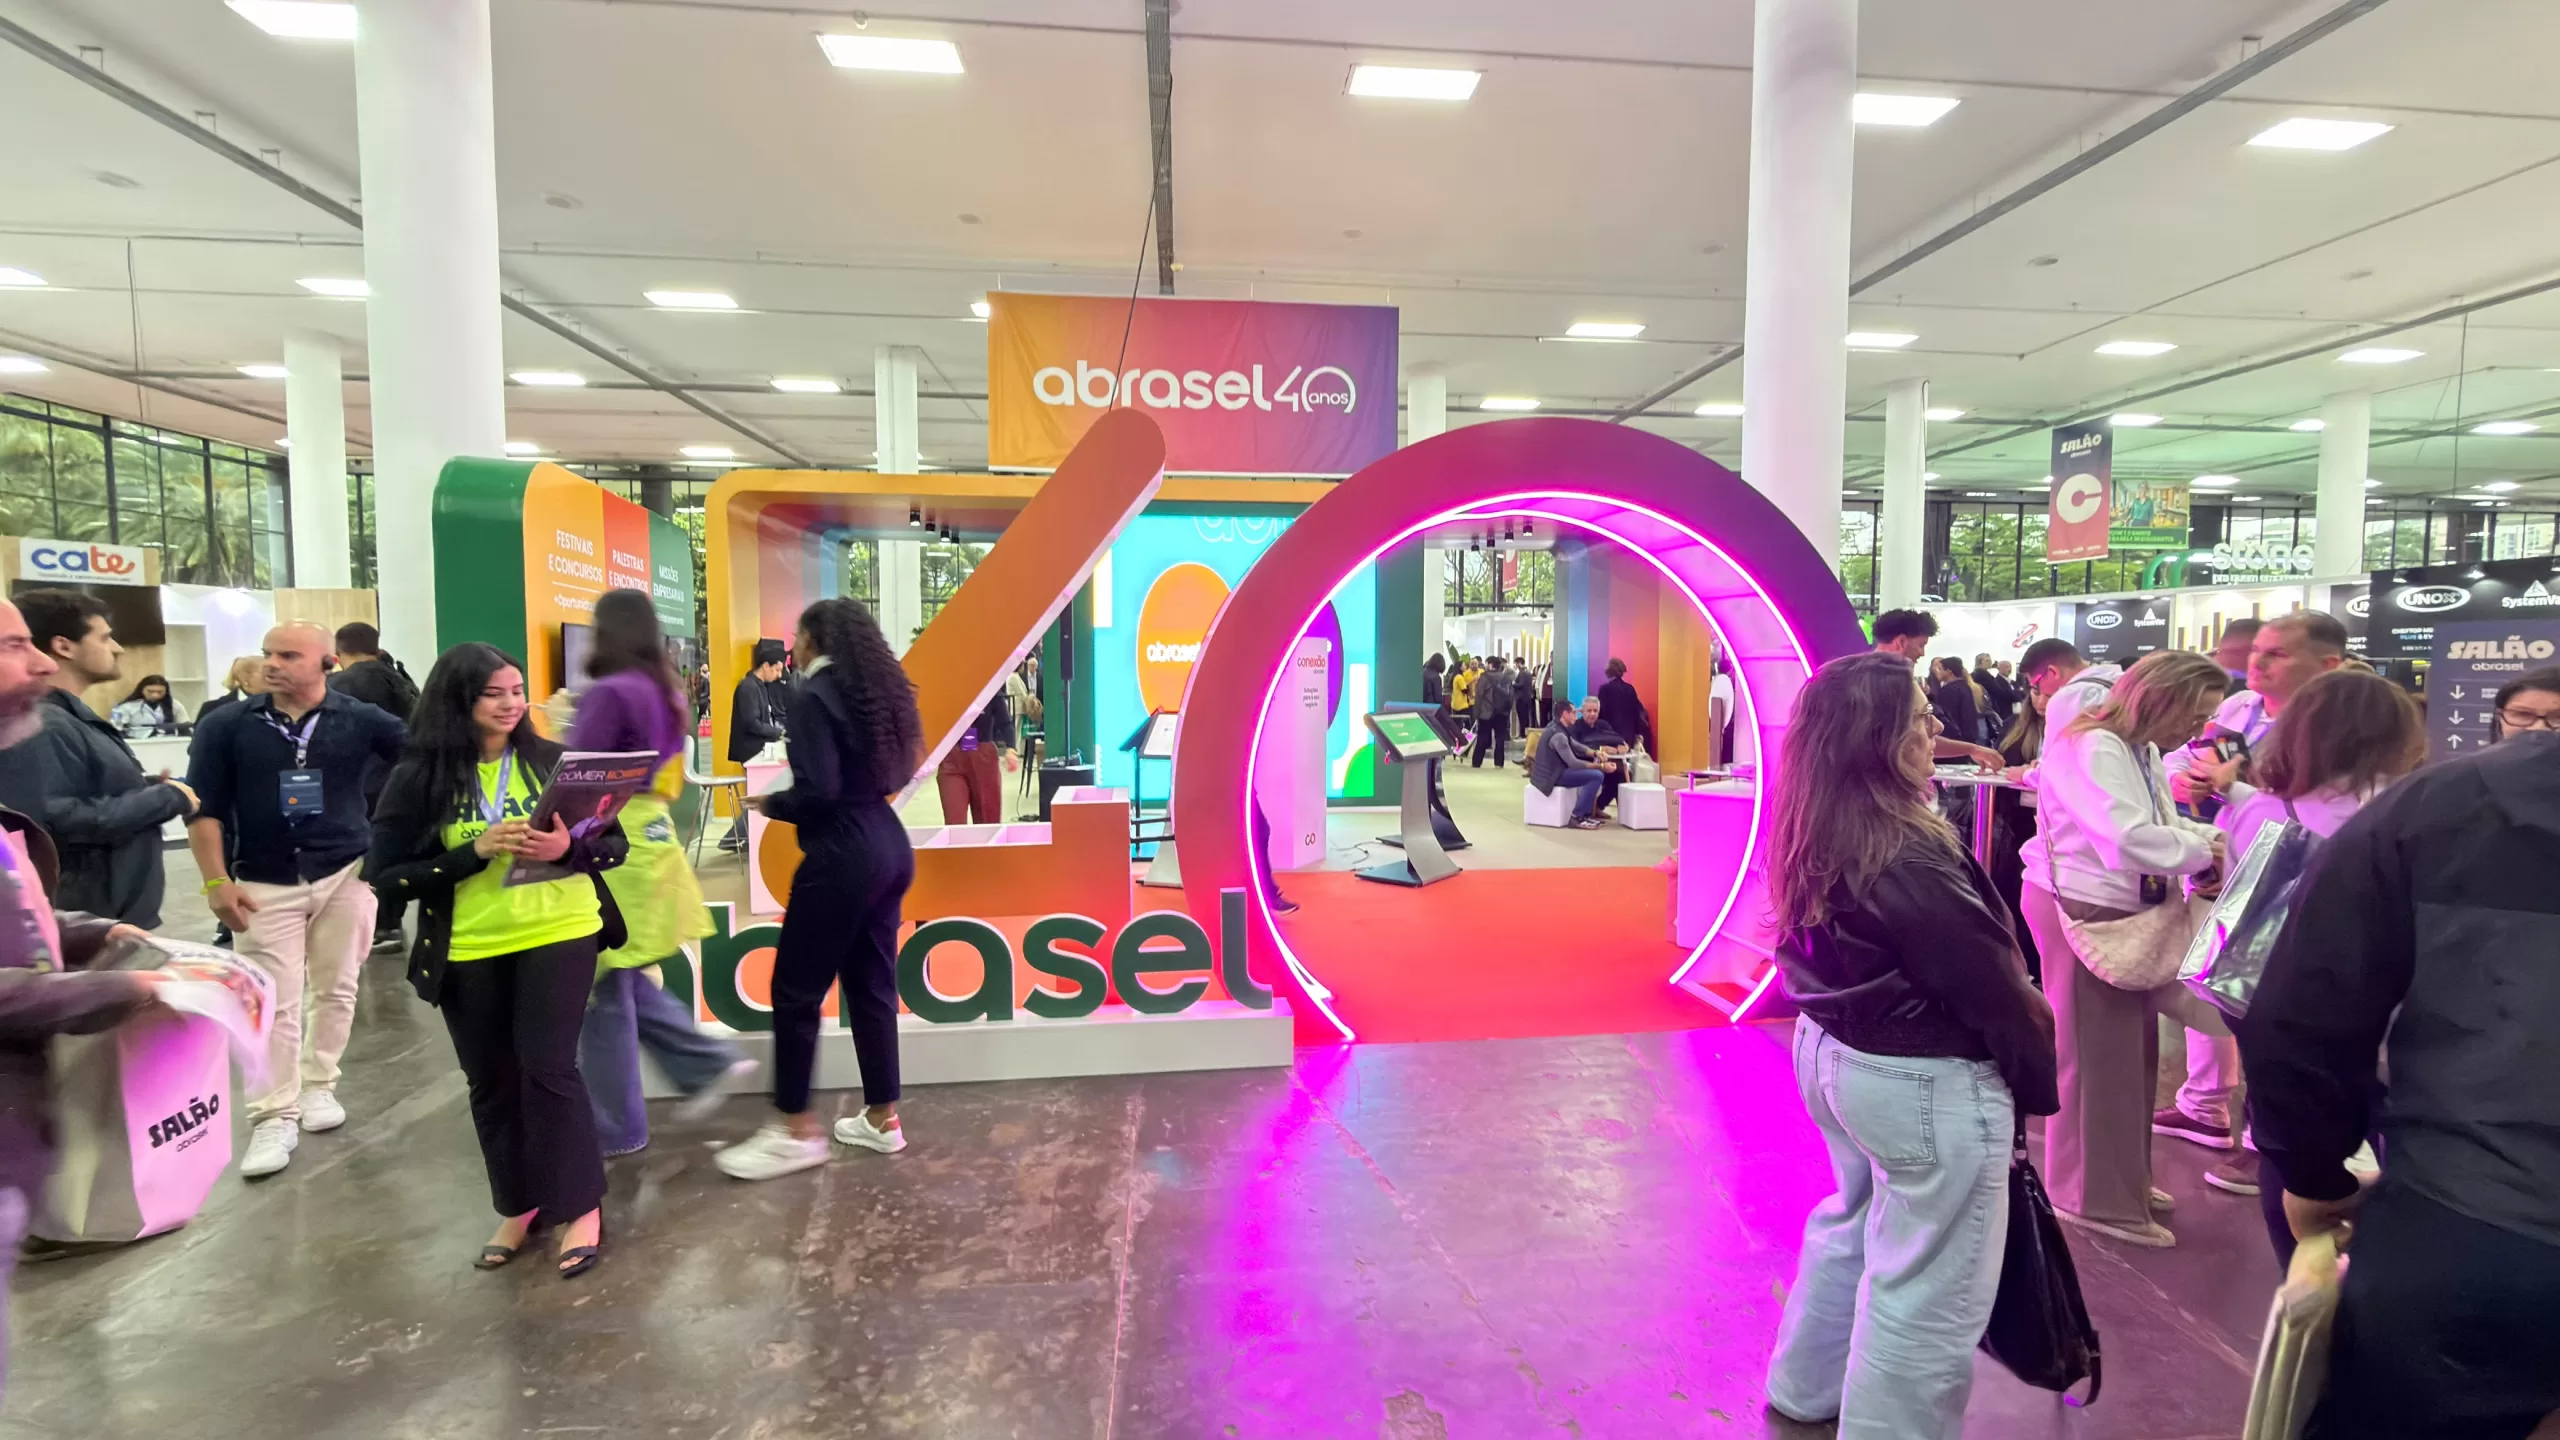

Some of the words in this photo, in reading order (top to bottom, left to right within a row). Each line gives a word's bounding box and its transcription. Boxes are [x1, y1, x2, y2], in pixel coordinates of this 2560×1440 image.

[1033, 359, 1272, 412] abrasel
[1308, 391, 1349, 406] anos
[2060, 433, 2102, 454] SALÃO
[2056, 473, 2103, 524] C
[556, 529, 594, 557] FESTIVAIS
[2213, 541, 2314, 571] stone
[31, 545, 135, 575] cate
[548, 553, 554, 571] E
[555, 556, 603, 584] CONCURSOS
[612, 549, 644, 573] PALESTRAS
[2404, 591, 2461, 606] UNOX
[2501, 594, 2560, 609] SystemVa
[2447, 635, 2555, 660] SALÃO
[1297, 654, 1326, 668] conexão
[2471, 661, 2524, 671] abrasel
[655, 887, 1274, 1033] basel
[148, 1093, 219, 1149] SALÃO
